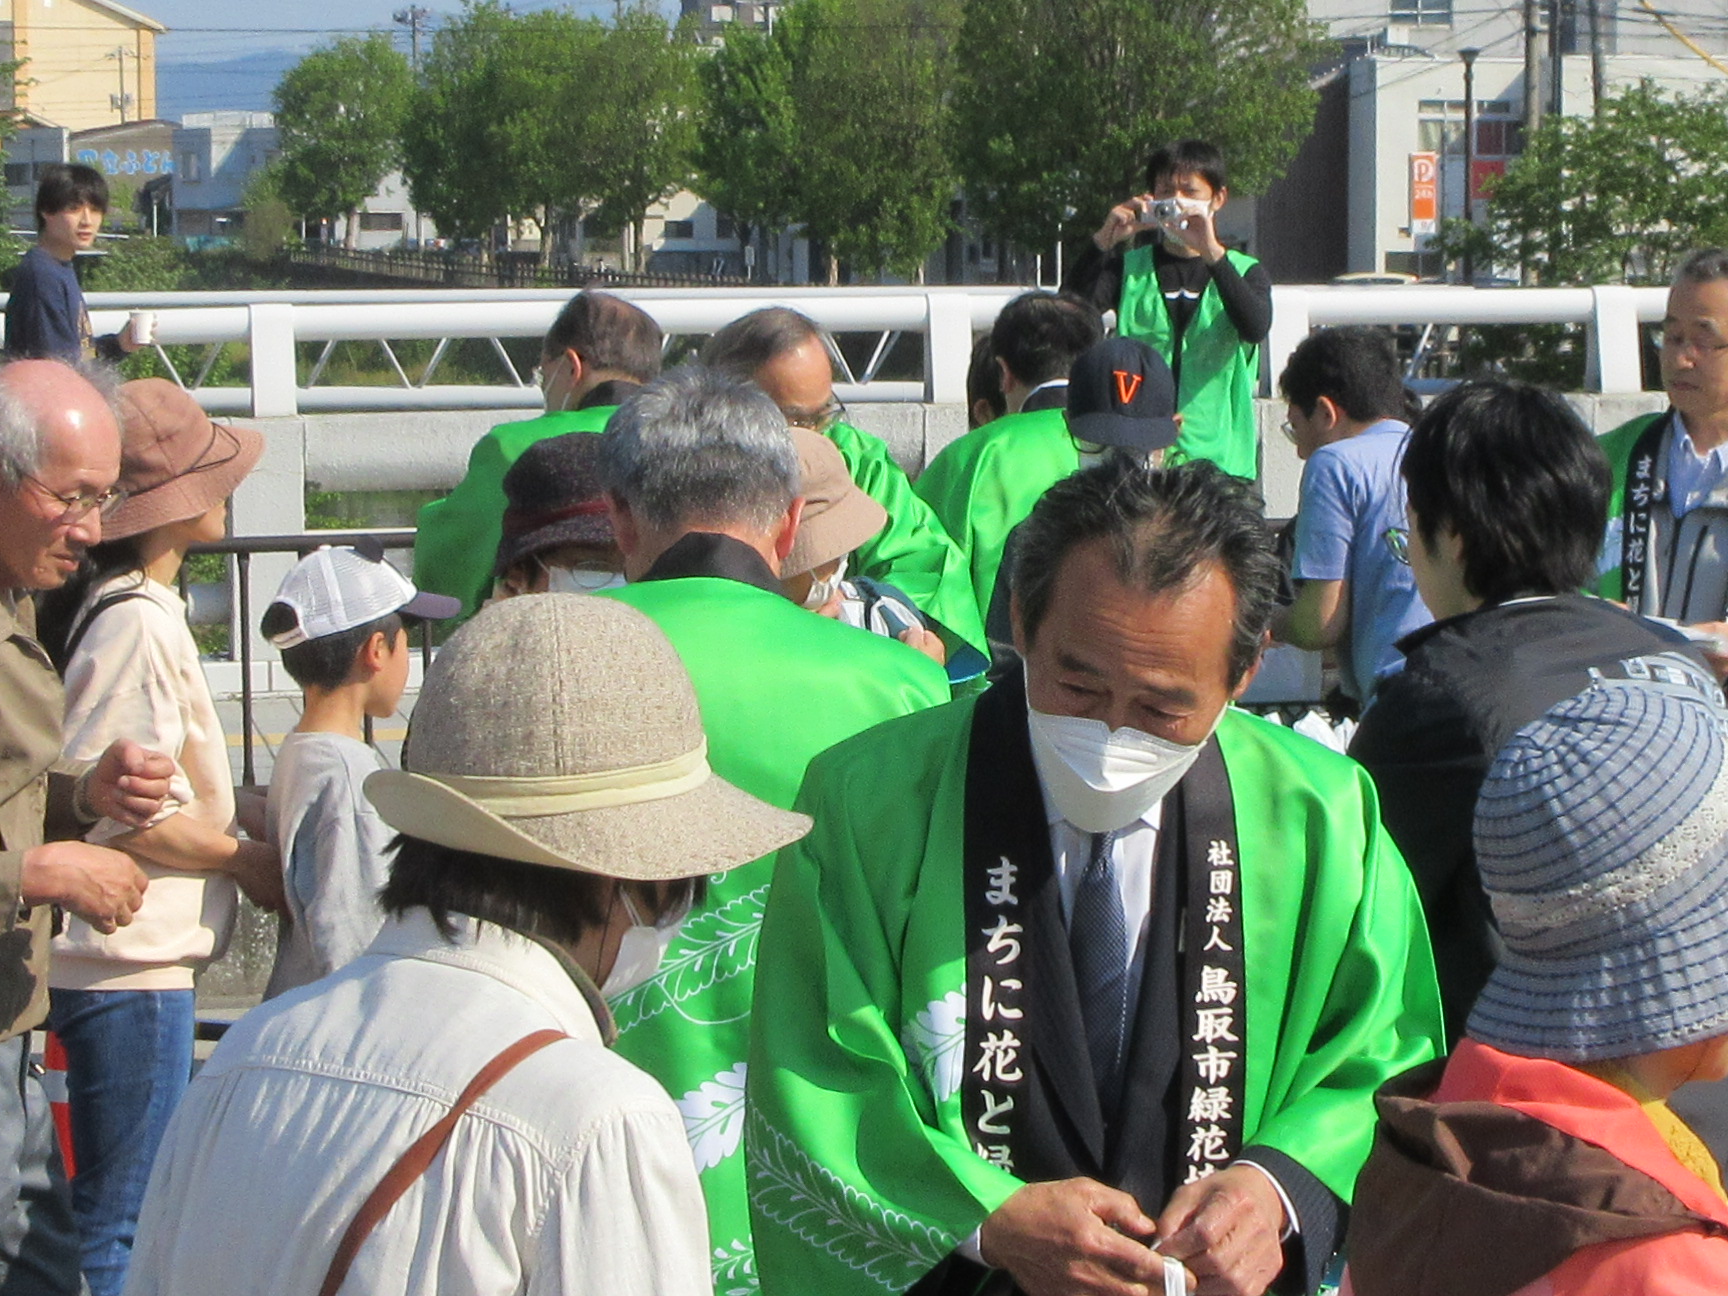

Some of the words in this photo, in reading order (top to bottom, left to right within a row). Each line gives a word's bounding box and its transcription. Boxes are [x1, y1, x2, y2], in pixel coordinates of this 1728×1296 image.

[1112, 369, 1144, 404] V
[1203, 840, 1235, 952] 社団法人
